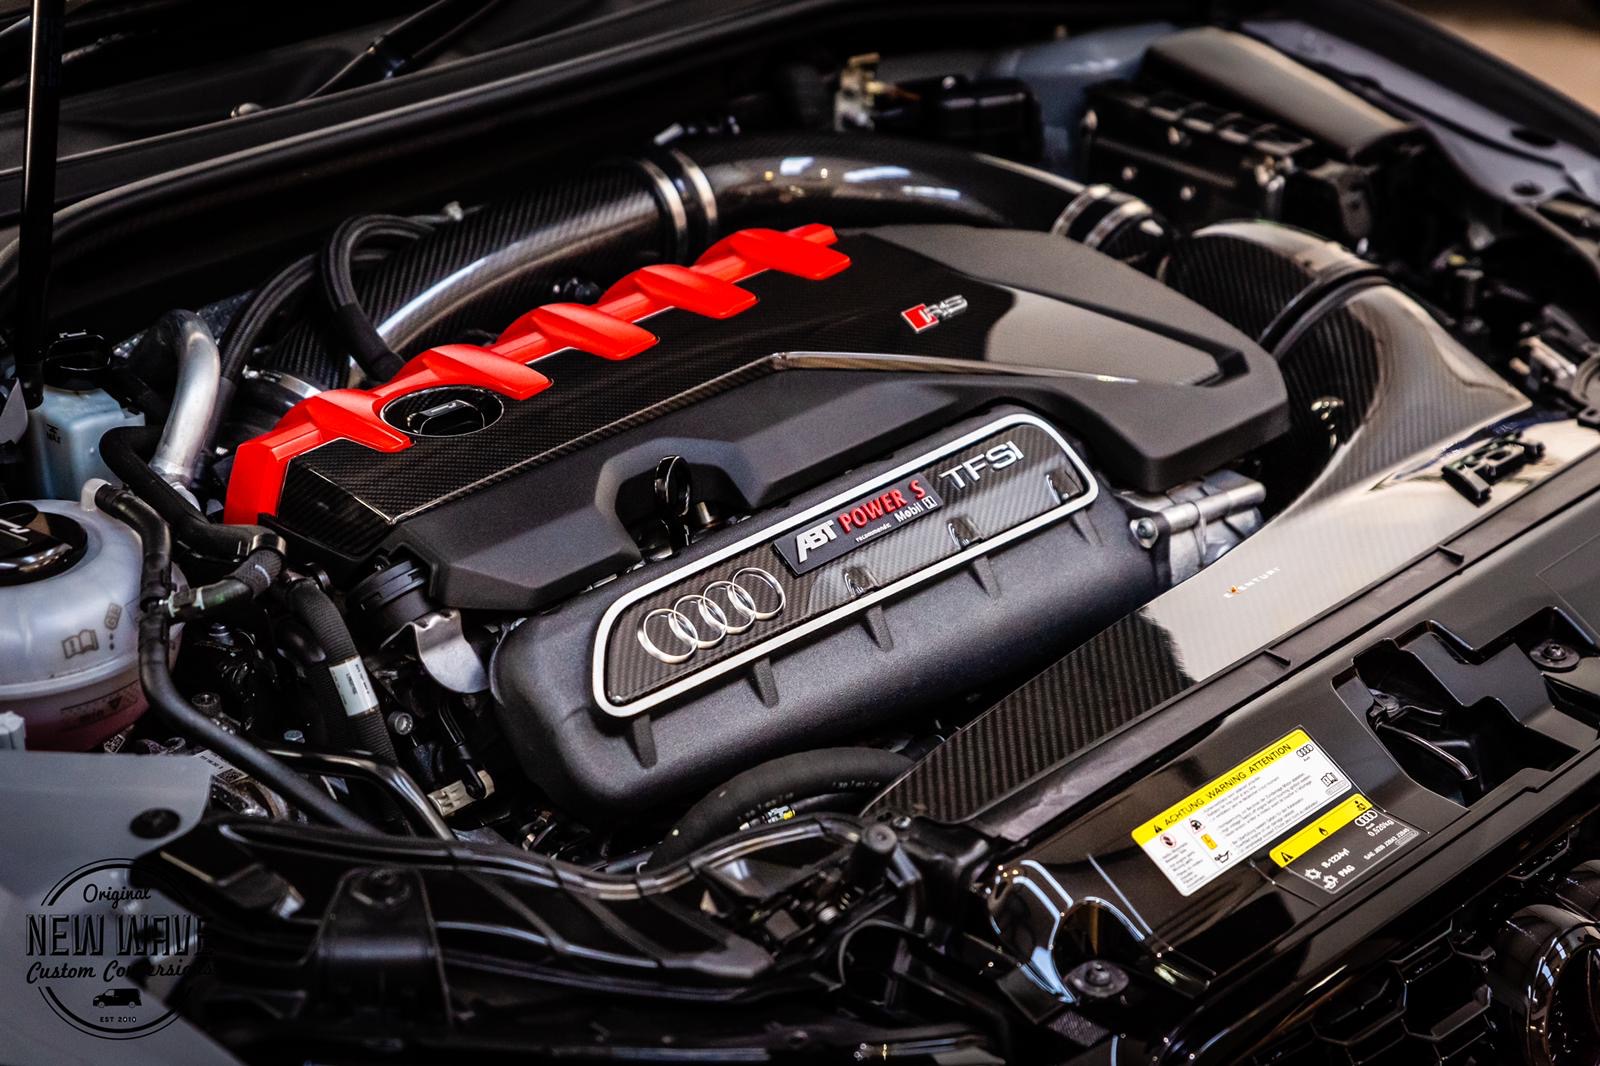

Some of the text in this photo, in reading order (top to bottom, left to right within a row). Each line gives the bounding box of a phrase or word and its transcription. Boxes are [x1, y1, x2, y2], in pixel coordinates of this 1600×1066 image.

[916, 294, 968, 325] RS
[940, 440, 1024, 489] TFSI
[795, 479, 926, 564] ABT POWER S
[894, 502, 924, 523] Mobil
[1164, 797, 1205, 826] ACHTUNG
[1206, 771, 1247, 799] WARNING
[1248, 743, 1292, 774] ATTENTION
